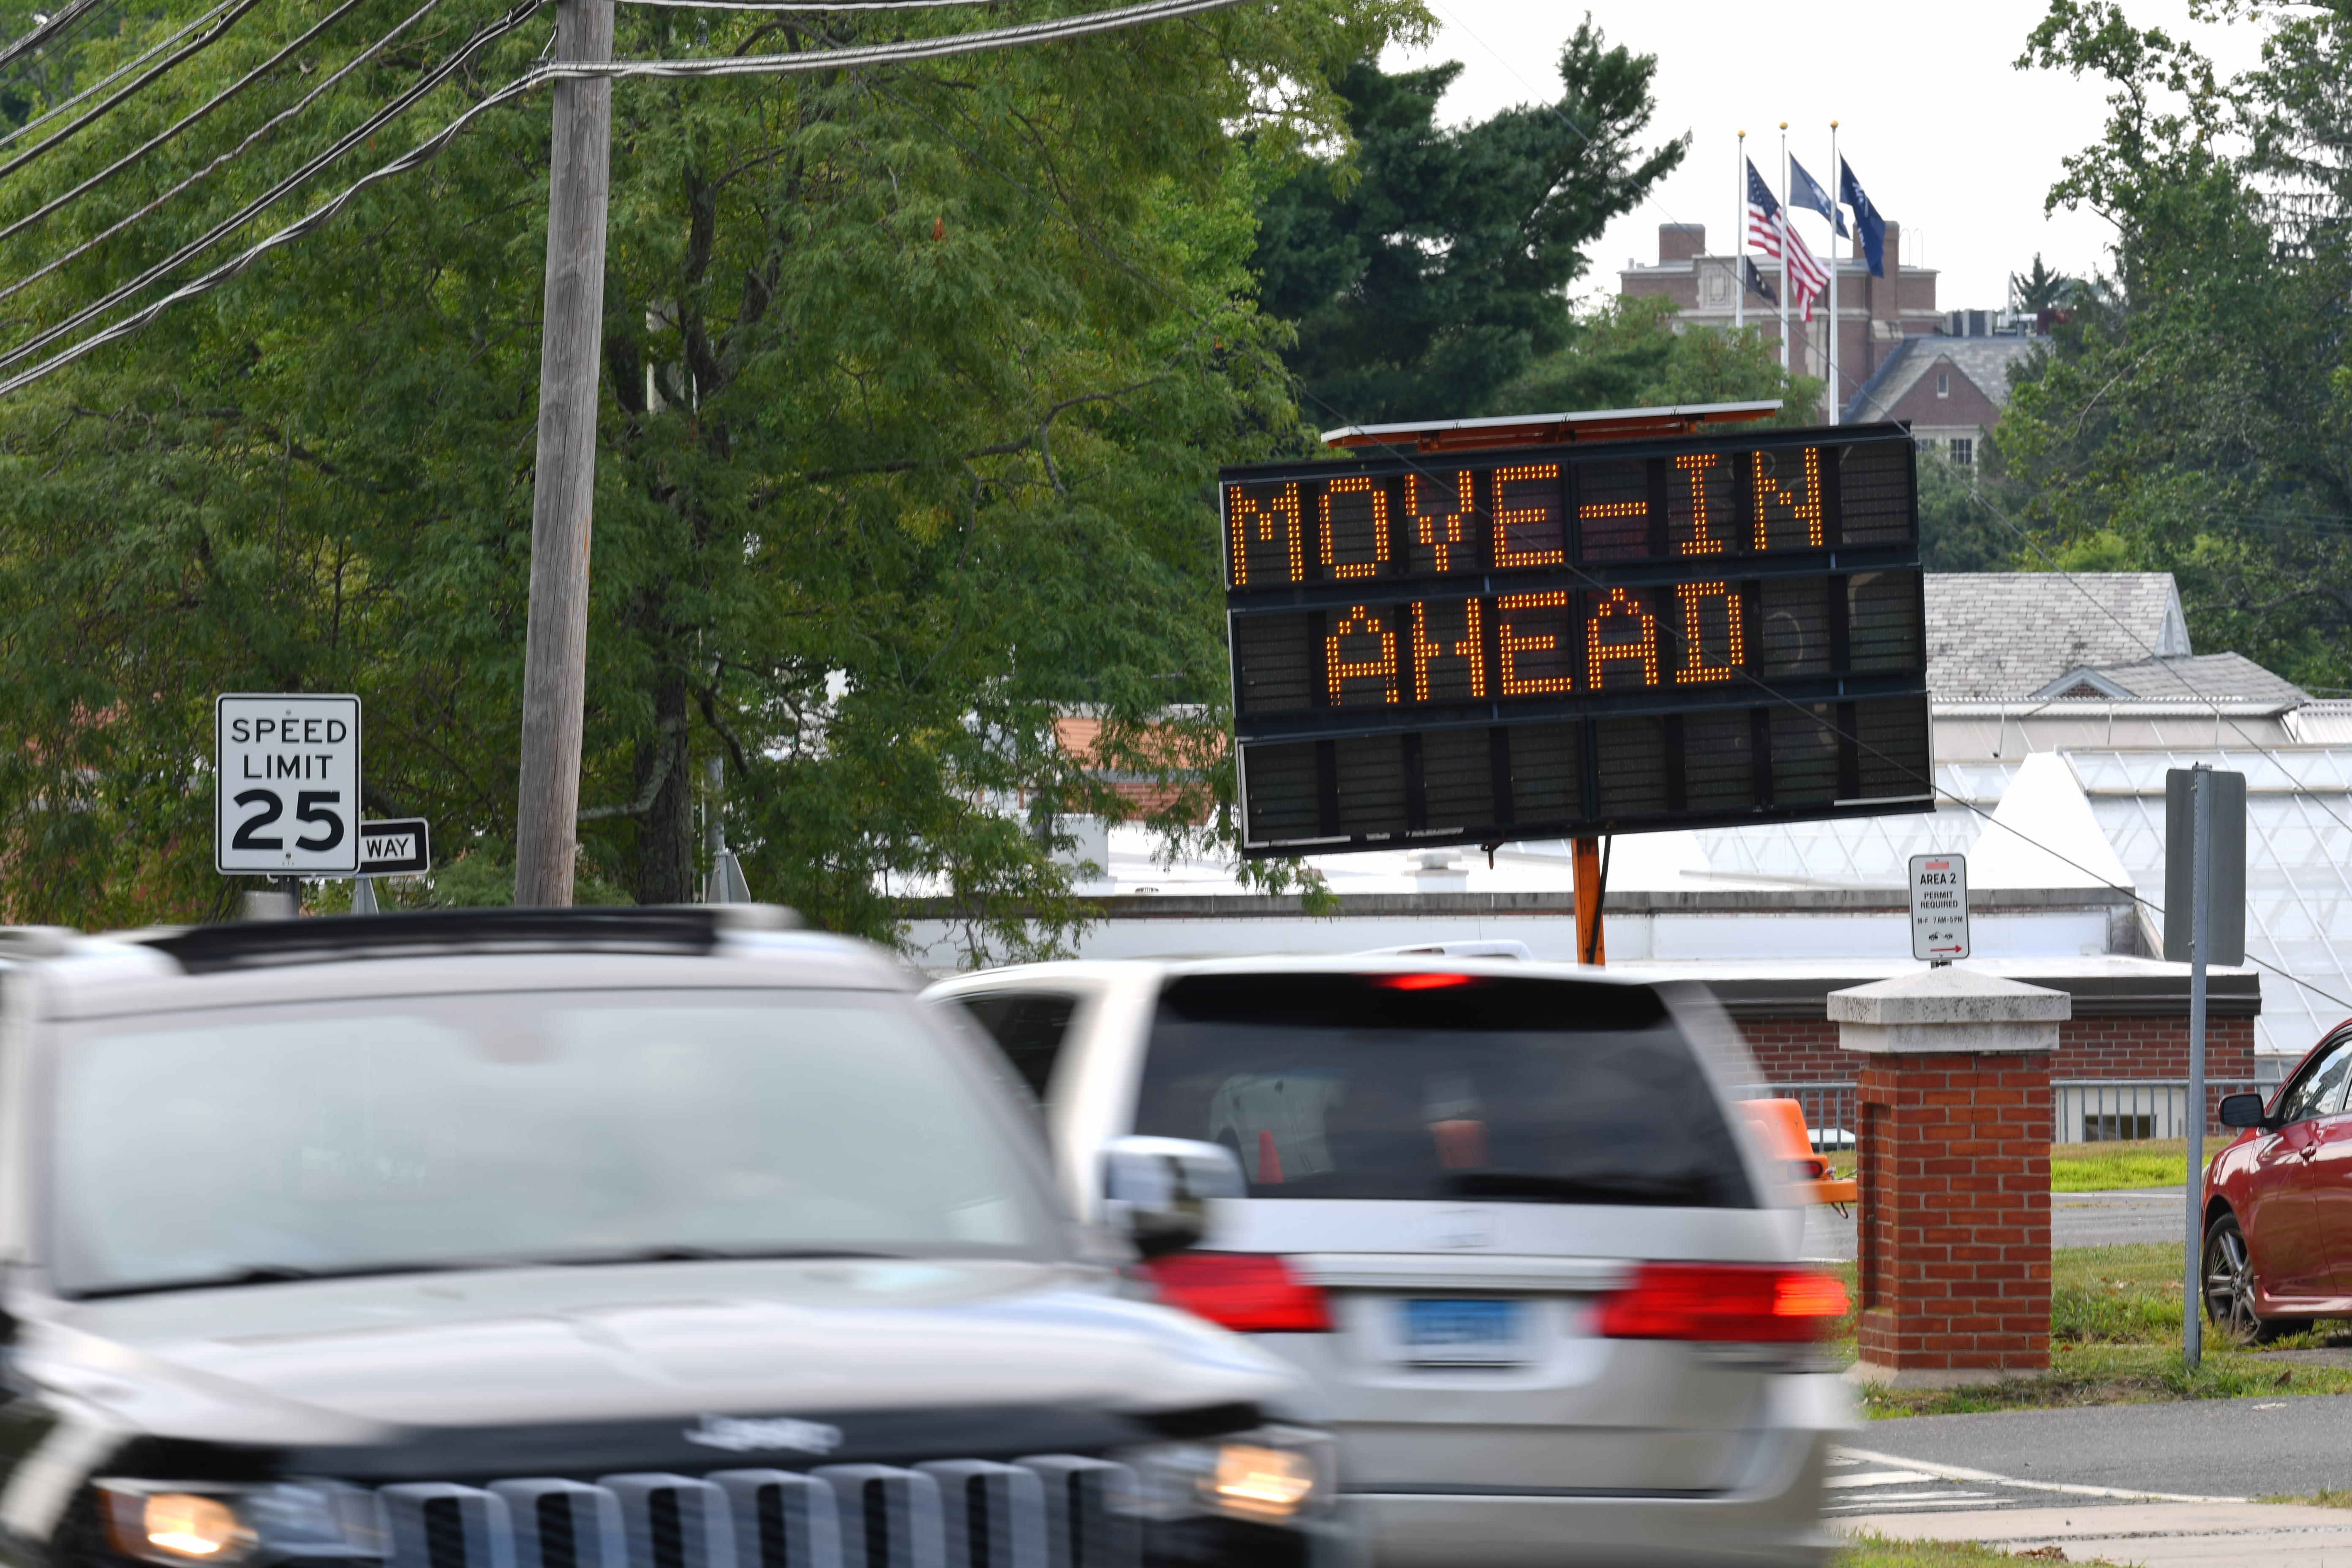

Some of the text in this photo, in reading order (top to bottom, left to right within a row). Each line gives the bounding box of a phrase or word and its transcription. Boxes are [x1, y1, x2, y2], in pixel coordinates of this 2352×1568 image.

[1230, 446, 1823, 586] MOVE-IN
[1326, 580, 1745, 706] AHEAD
[231, 718, 347, 744] SPEED
[243, 754, 333, 780] LIMIT
[231, 788, 345, 851] 25
[366, 837, 409, 859] WAY
[1920, 872, 1957, 885] AREA 2
[1920, 899, 1958, 909] REQUIRED
[1924, 890, 1954, 900] PERMIT
[1917, 917, 1928, 926] M-F
